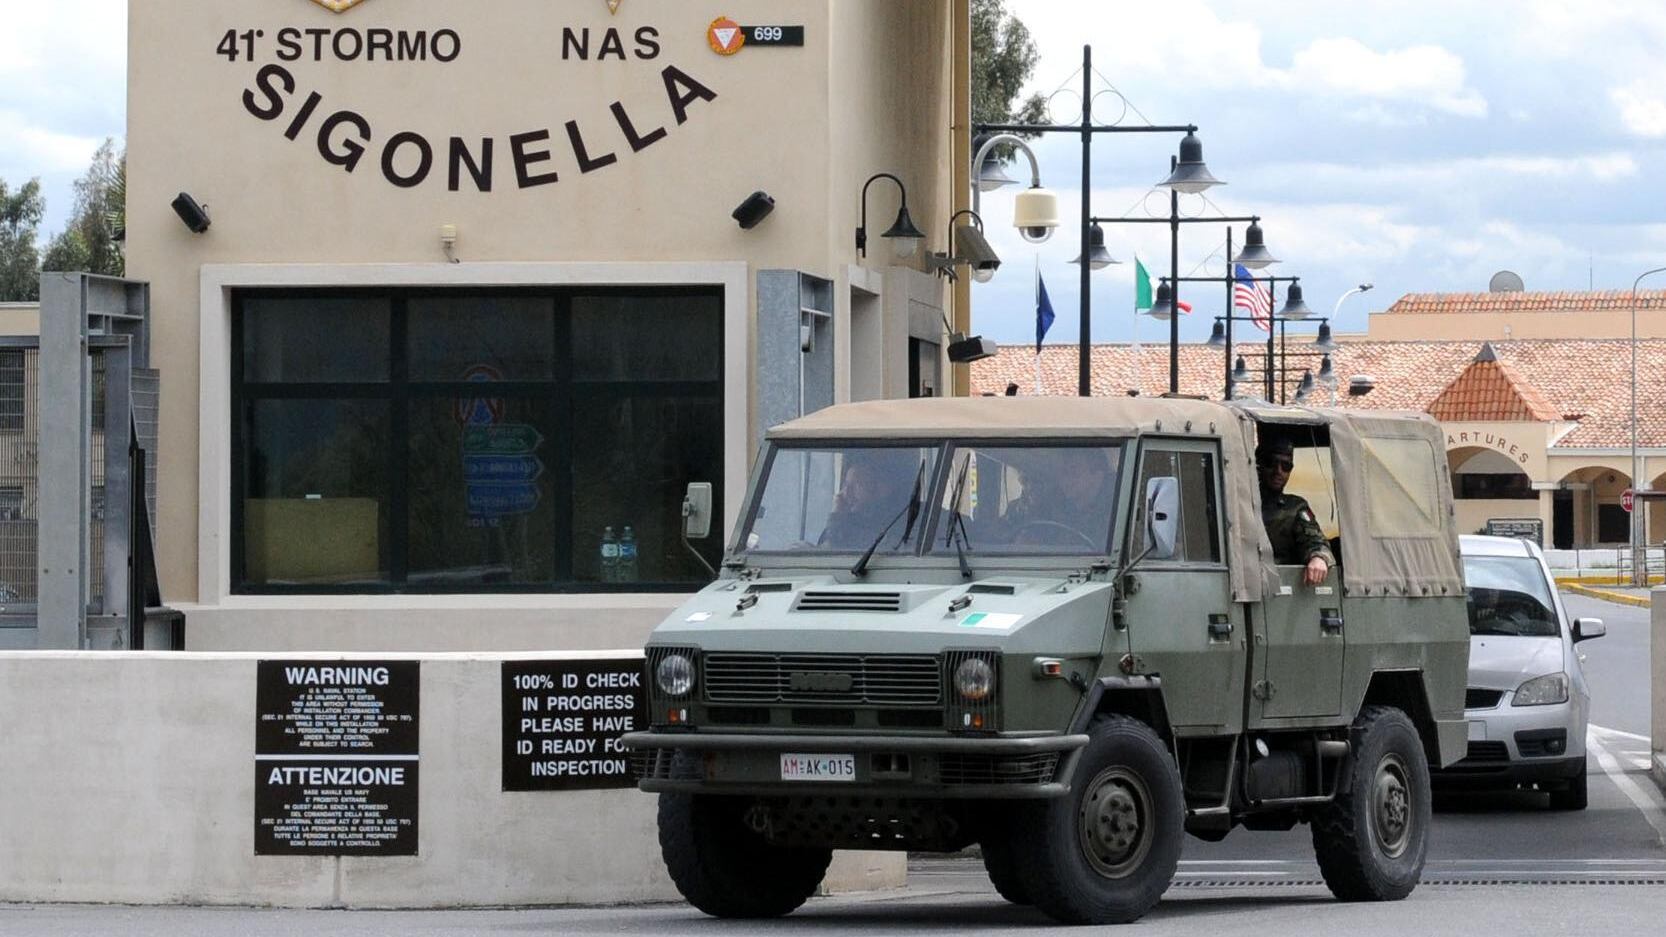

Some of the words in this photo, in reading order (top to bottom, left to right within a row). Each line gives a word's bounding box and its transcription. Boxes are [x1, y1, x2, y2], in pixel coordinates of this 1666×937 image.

[753, 26, 783, 41] 699
[276, 28, 461, 62] STORMO
[562, 27, 661, 60] NAS
[241, 64, 718, 193] SIGONELLA
[285, 667, 389, 685] WARNING
[513, 674, 554, 689] 100%
[562, 674, 578, 688] ID
[586, 672, 641, 687] CHECK
[522, 697, 538, 711] IN
[547, 695, 634, 711] PROGRESS
[521, 717, 584, 732] PLEASE
[593, 716, 634, 731] HAVE
[517, 740, 533, 754] ID
[542, 739, 596, 754] READY
[605, 738, 632, 753] FO
[531, 760, 626, 776] INSPECTION
[806, 759, 822, 775] AK
[828, 759, 853, 775] 015
[268, 767, 405, 785] ATTENZIONE
